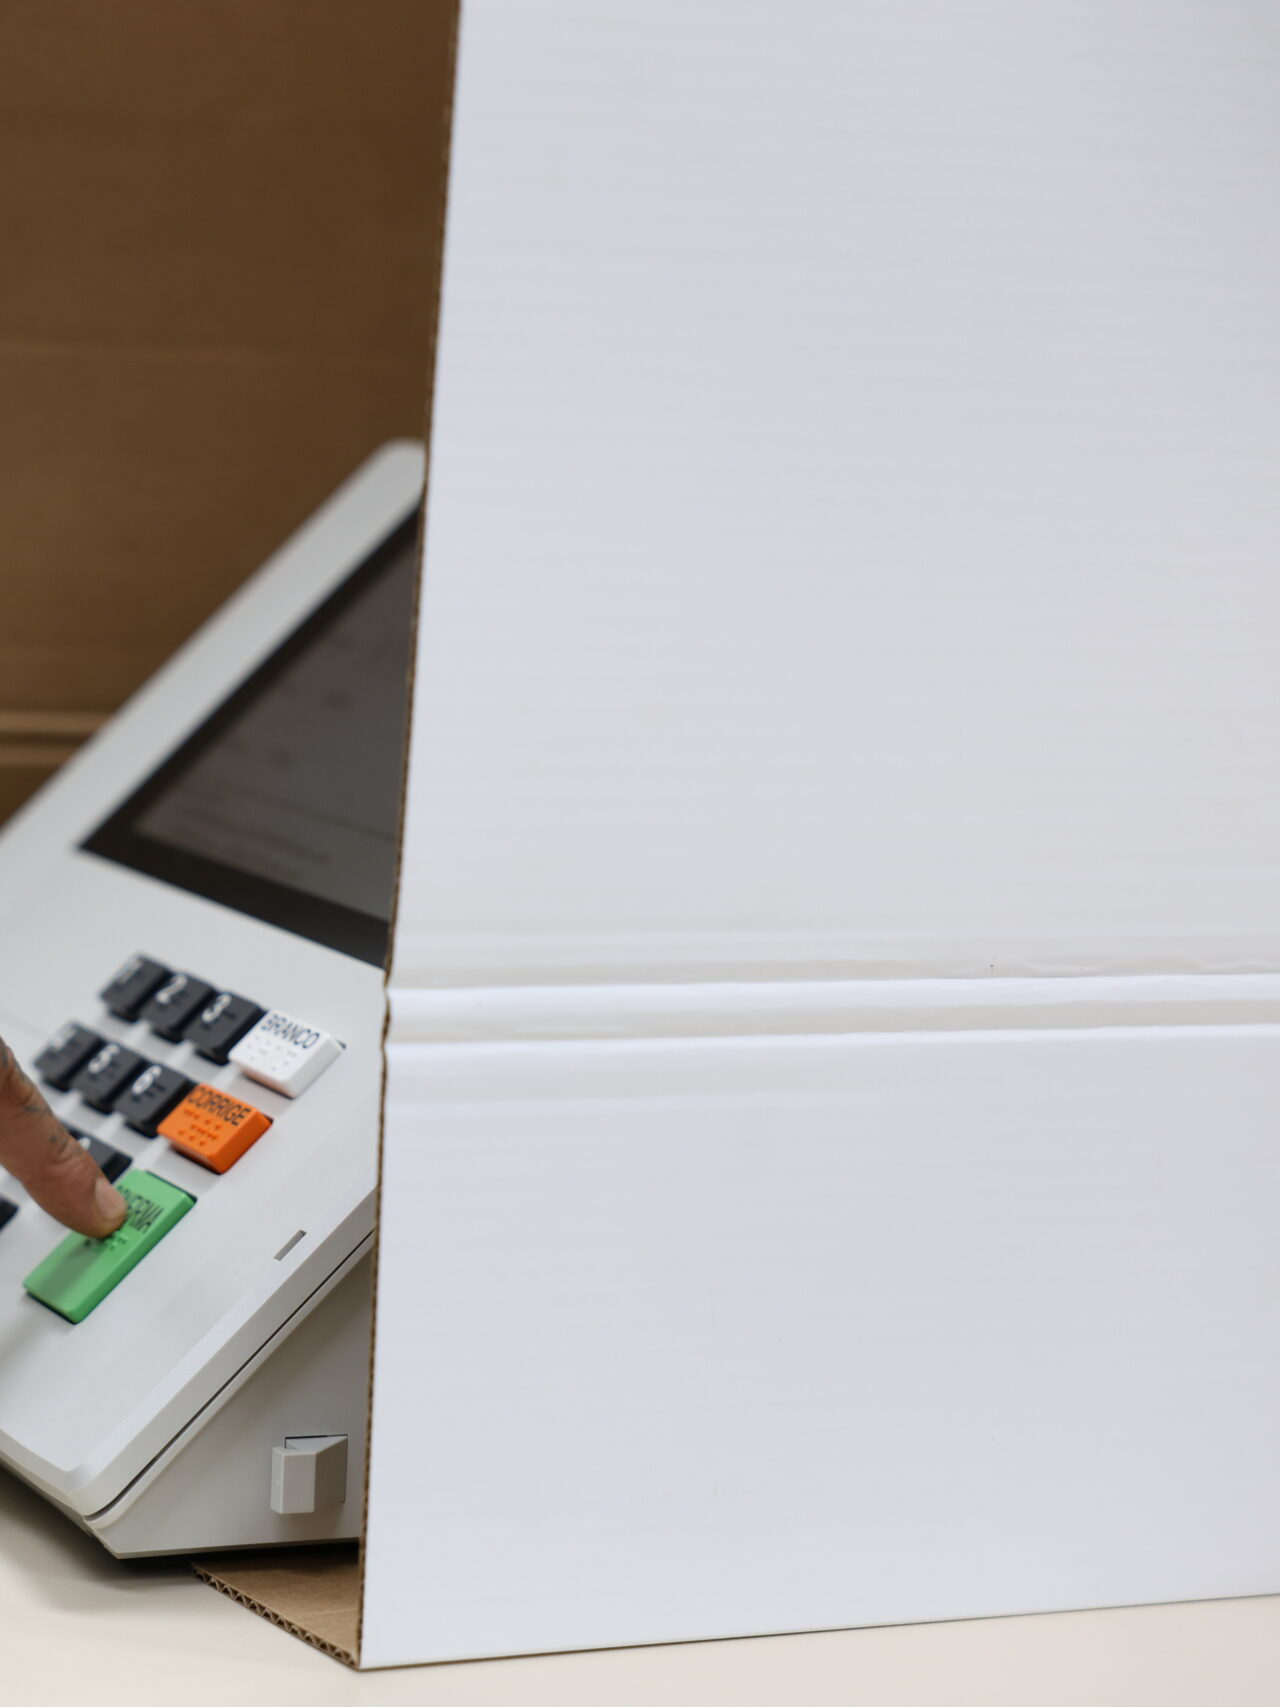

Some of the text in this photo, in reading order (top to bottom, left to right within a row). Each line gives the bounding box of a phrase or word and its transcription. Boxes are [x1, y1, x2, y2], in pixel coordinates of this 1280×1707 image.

[155, 973, 188, 1004] 2
[201, 991, 233, 1023] 3
[260, 1013, 321, 1050] BRANCO
[87, 1043, 120, 1075] 5
[131, 1065, 163, 1096] 6
[187, 1087, 252, 1127] CORRIGE
